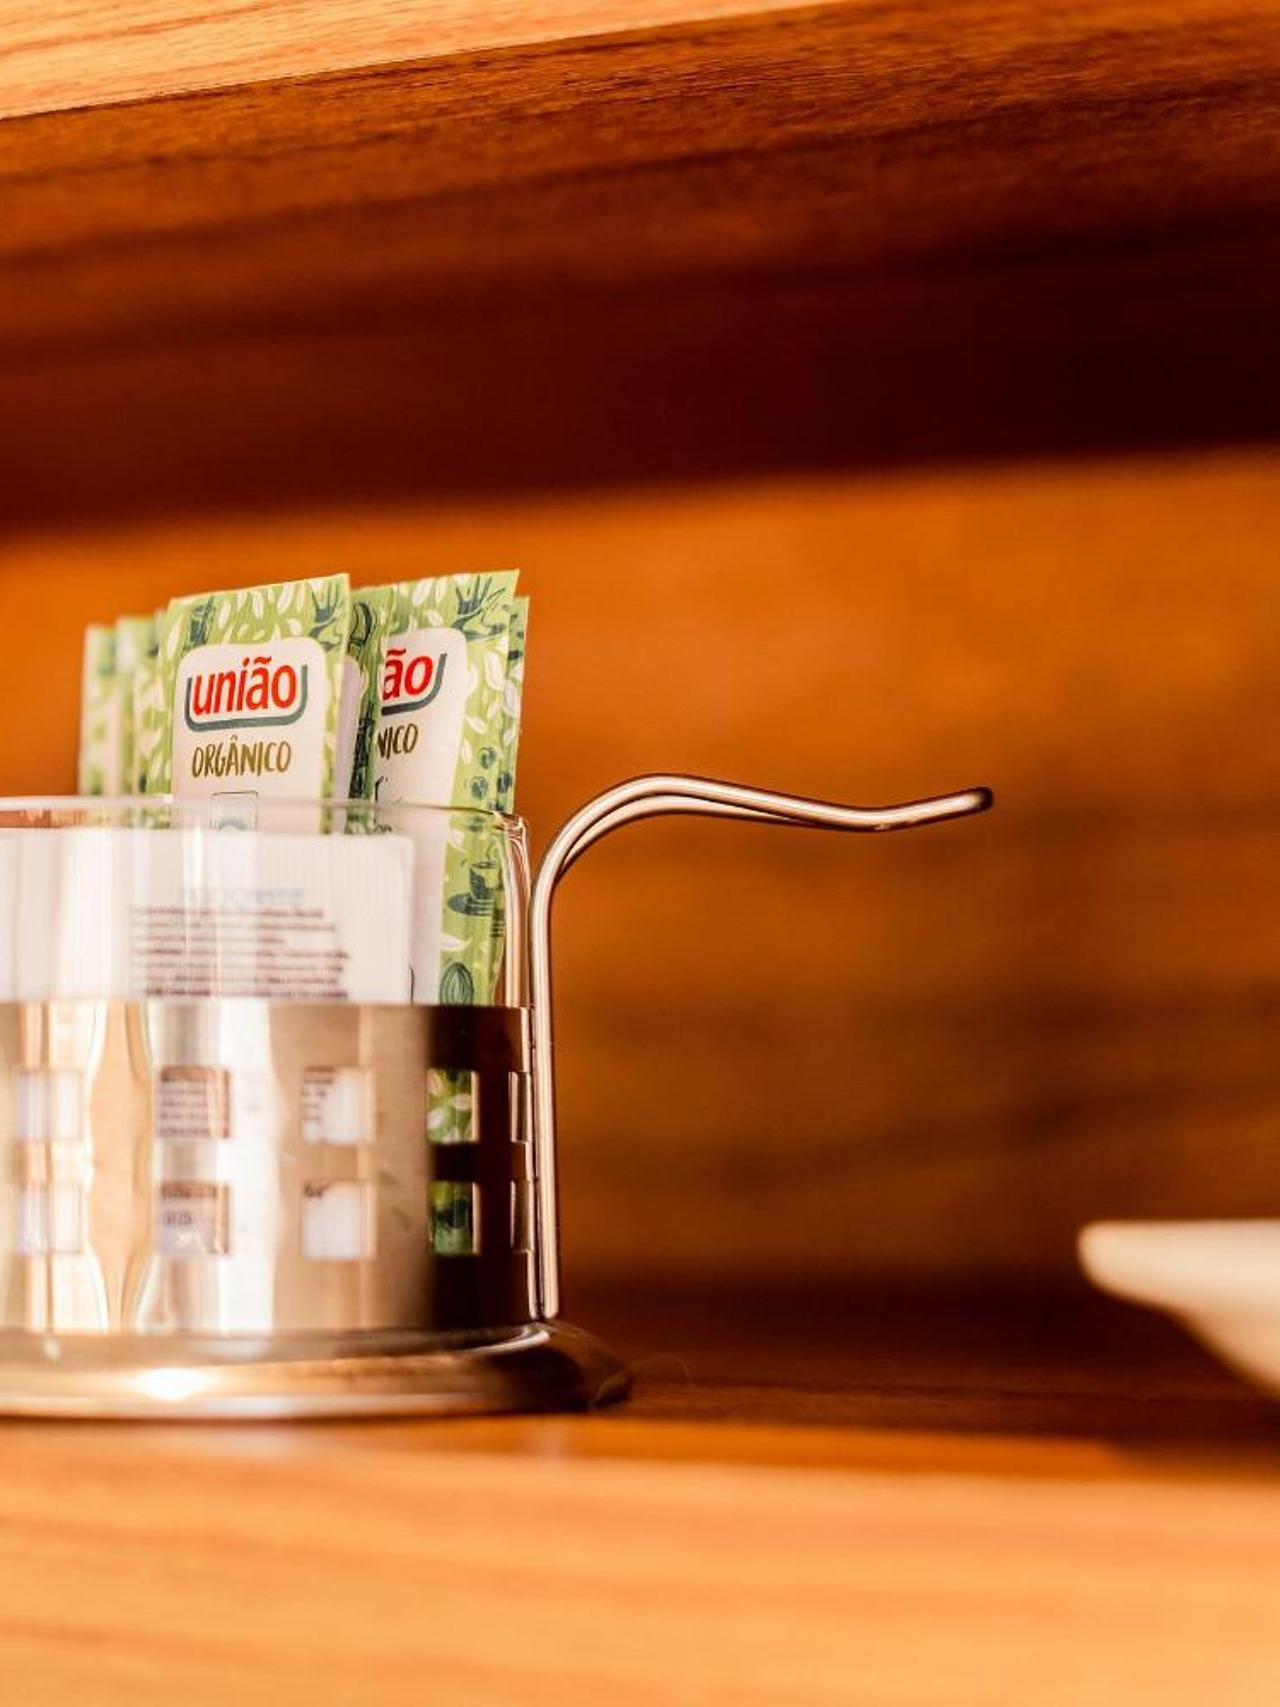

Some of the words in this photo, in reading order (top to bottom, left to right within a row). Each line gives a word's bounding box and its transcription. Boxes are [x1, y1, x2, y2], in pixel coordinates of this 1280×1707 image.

[192, 655, 297, 717] união
[192, 734, 292, 779] ORGÂNICO
[377, 722, 419, 760] NICO
